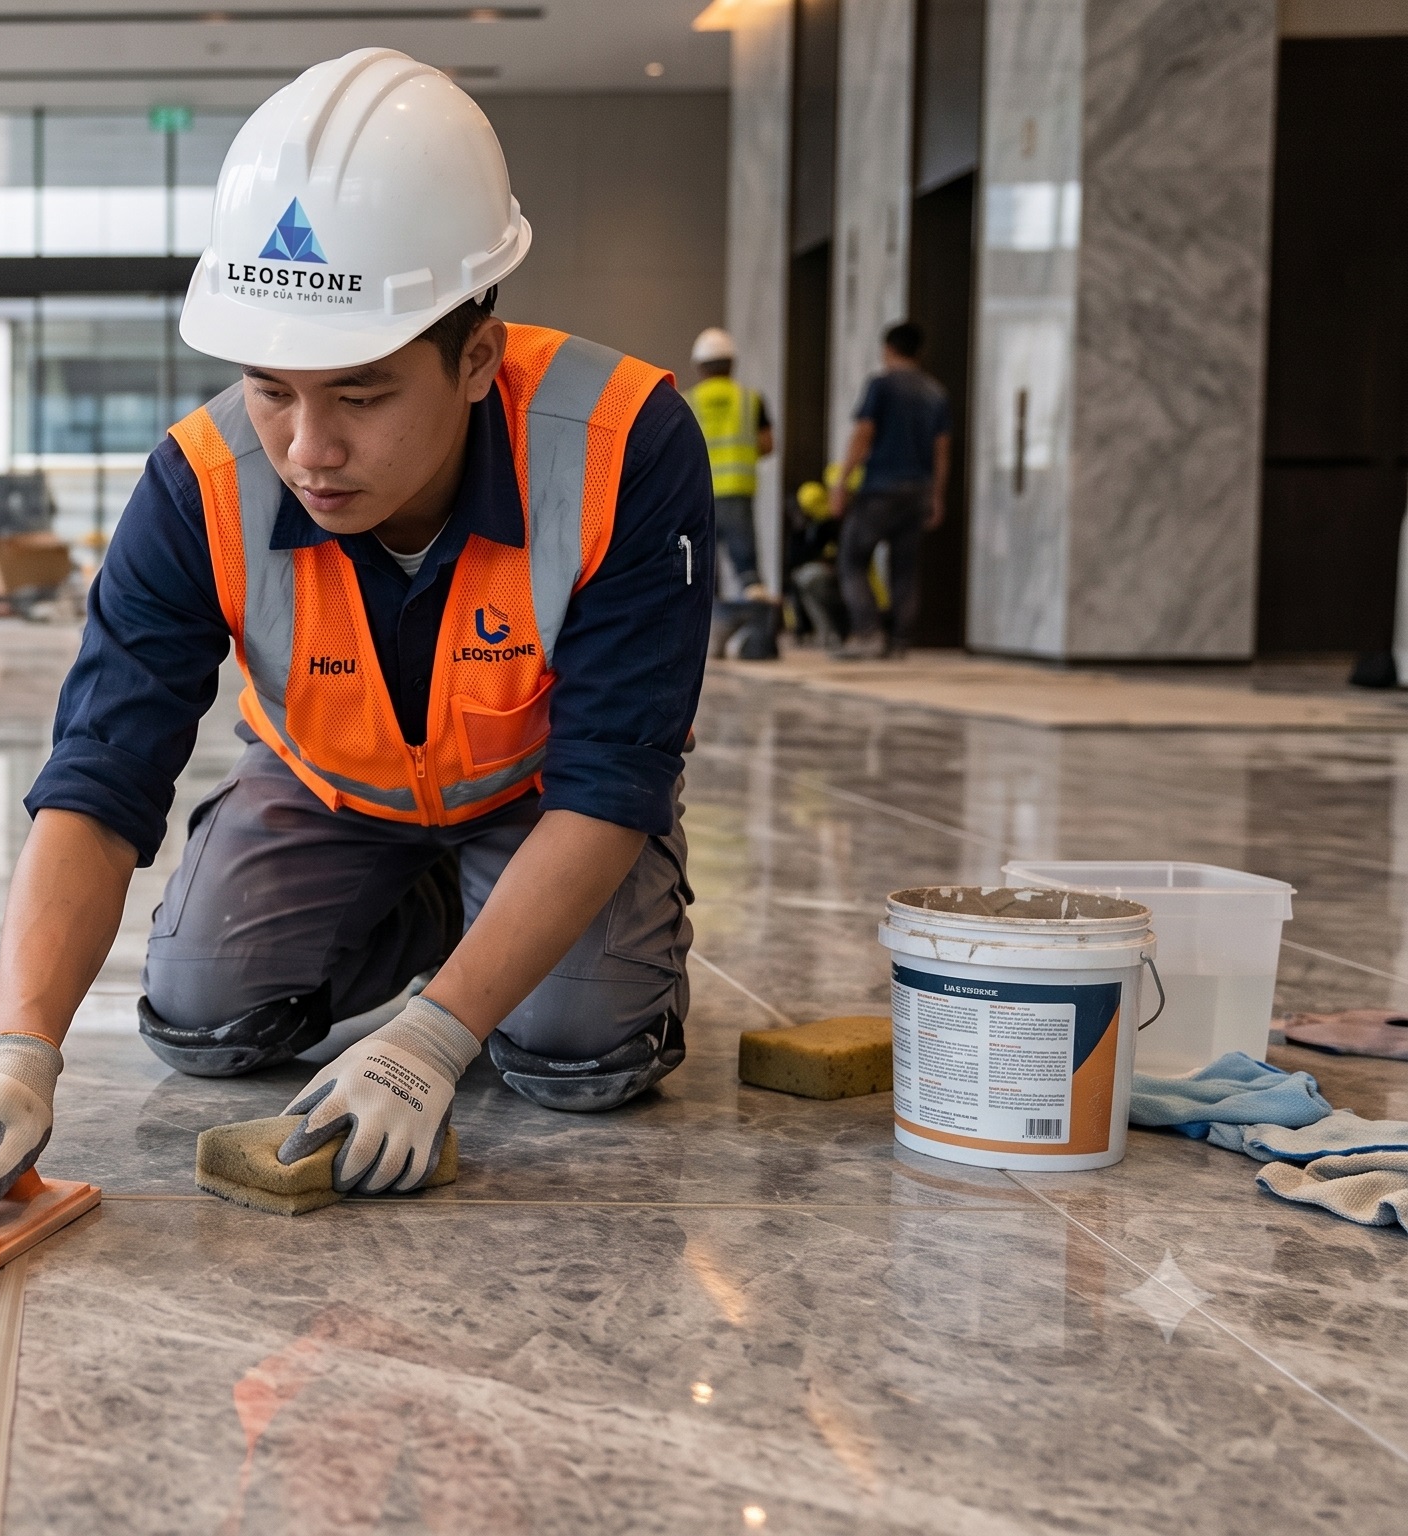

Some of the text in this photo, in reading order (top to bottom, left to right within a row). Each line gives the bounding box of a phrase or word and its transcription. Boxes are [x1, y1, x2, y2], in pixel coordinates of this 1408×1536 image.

[228, 263, 362, 292] LEOSTONE
[327, 295, 353, 304] GIAN
[453, 643, 537, 663] LEOSTONE
